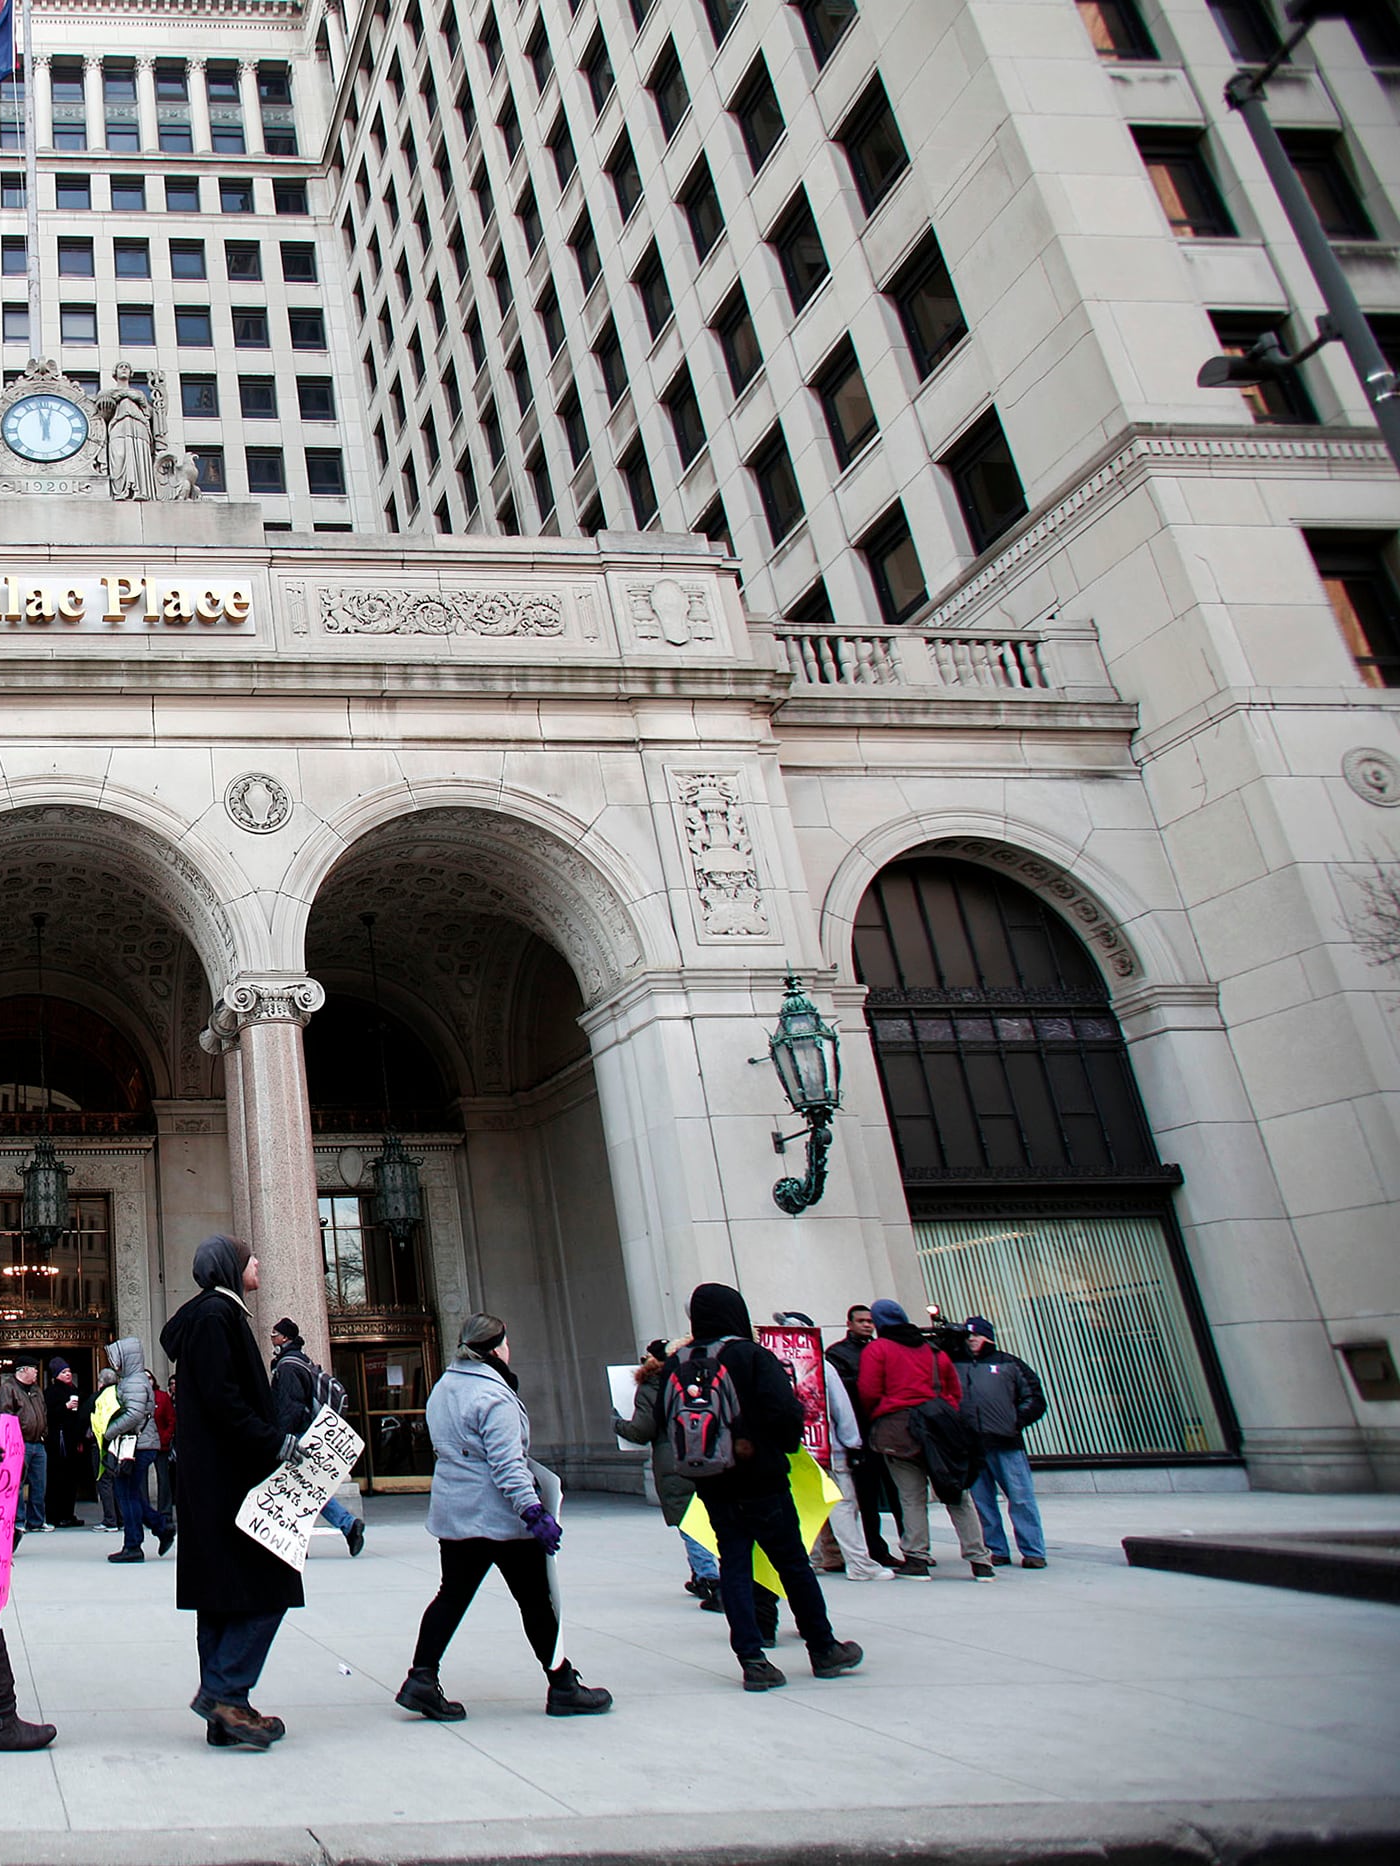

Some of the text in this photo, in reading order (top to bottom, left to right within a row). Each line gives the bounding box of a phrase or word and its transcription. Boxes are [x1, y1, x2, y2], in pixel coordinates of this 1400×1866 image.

[24, 481, 68, 491] 1920
[100, 575, 251, 625] Place
[304, 1435, 340, 1480] Restore
[315, 1411, 358, 1466] Petition
[268, 1473, 302, 1507] Rights
[296, 1507, 318, 1518] of
[249, 1517, 292, 1555] NOW!
[257, 1492, 308, 1548] Detroiters
